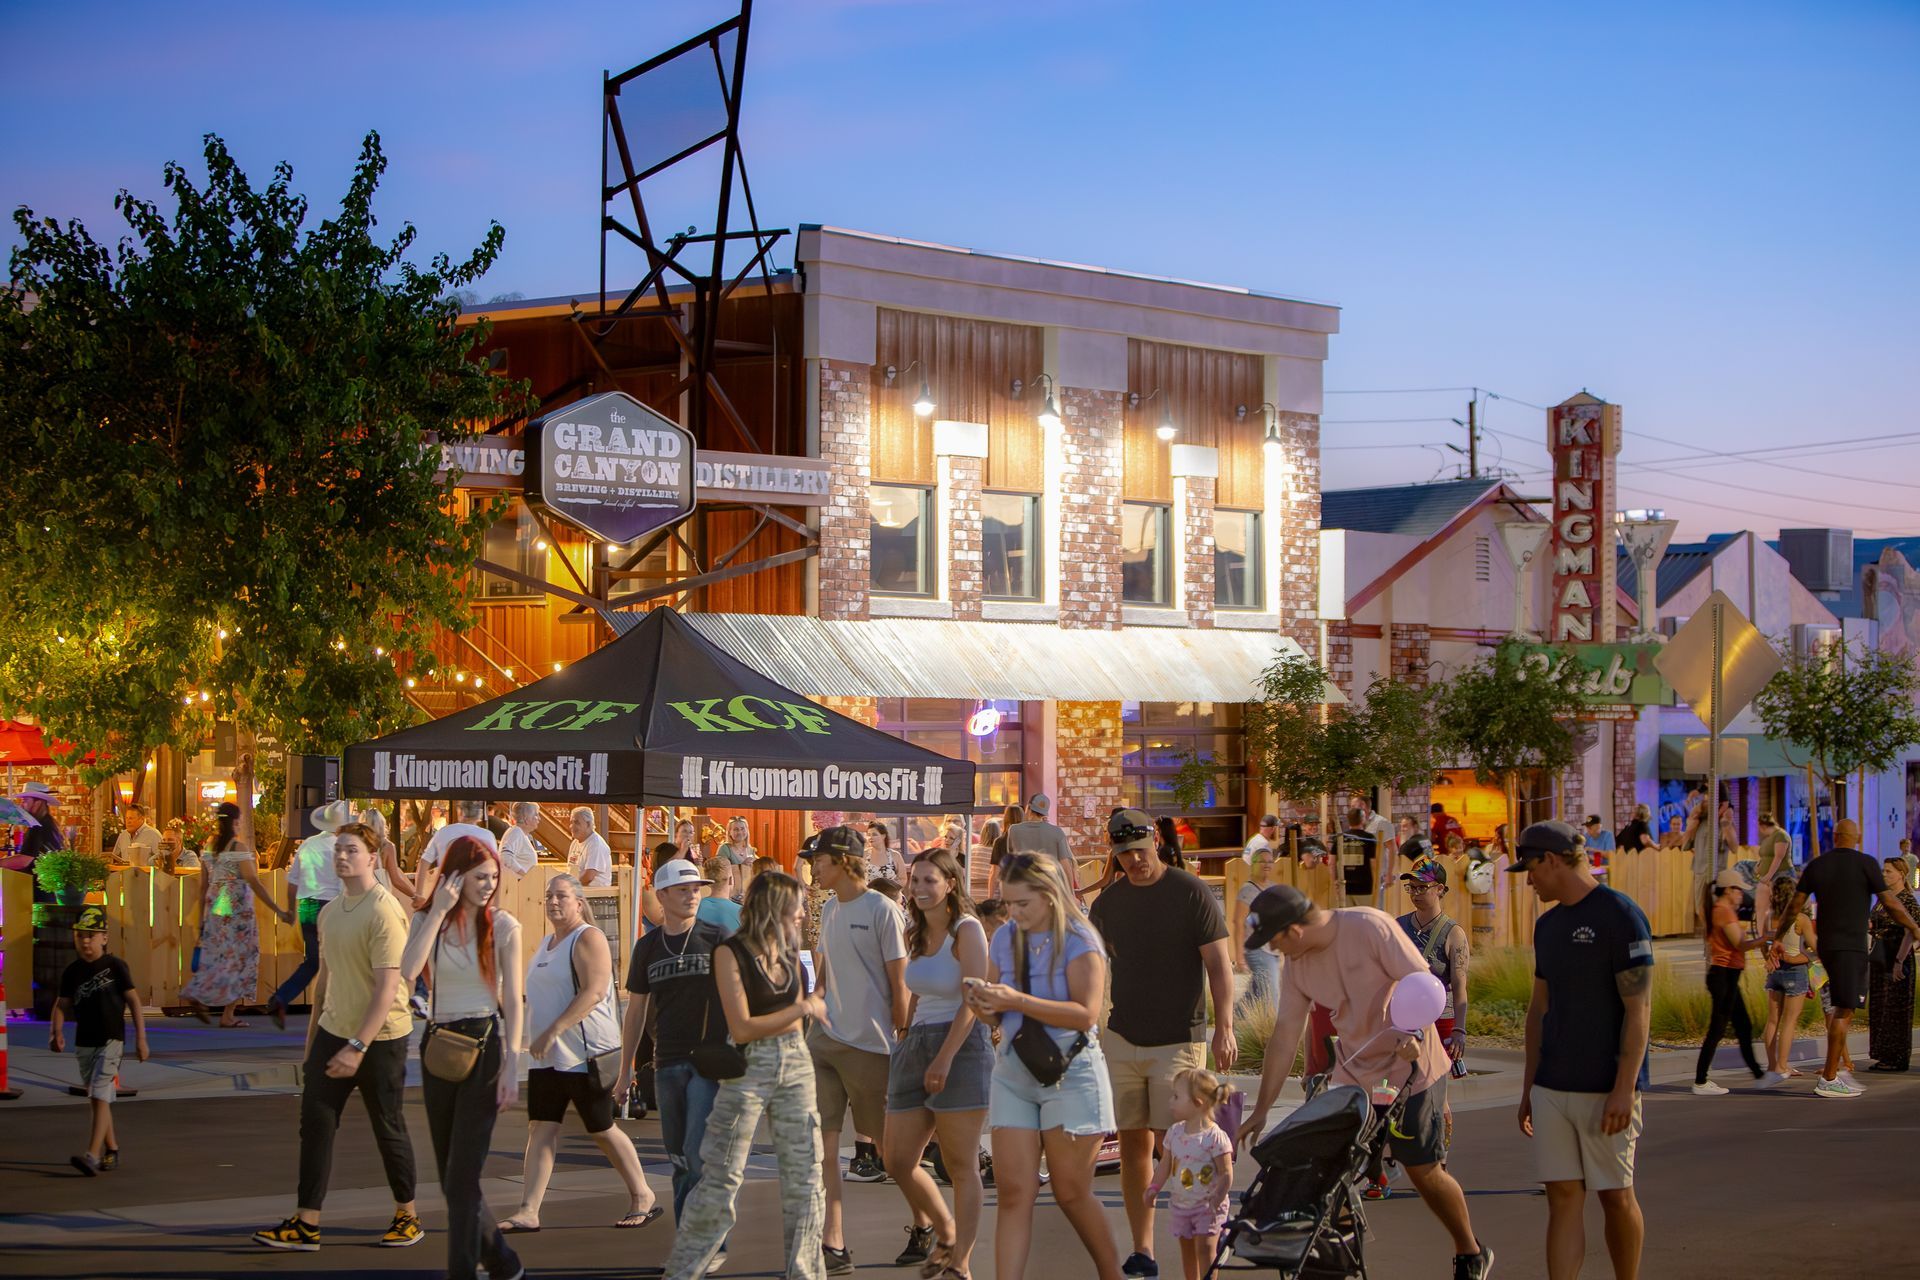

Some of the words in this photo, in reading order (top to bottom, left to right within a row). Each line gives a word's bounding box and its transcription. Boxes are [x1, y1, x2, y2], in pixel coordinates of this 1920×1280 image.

[610, 406, 626, 424] the
[554, 422, 681, 458] GRAND
[400, 441, 525, 475] EWING
[554, 453, 681, 486] CANYON
[555, 482, 608, 495] BREWING
[617, 487, 680, 500] DISTILLERY
[696, 461, 832, 496] DISTILLERY
[1560, 418, 1595, 641] KINGMAN
[464, 700, 639, 732] KCF
[667, 694, 832, 735] KCF
[395, 754, 489, 792] Kingman
[493, 754, 584, 791] CrossFit
[708, 760, 818, 801] Kingman
[823, 764, 918, 801] CrossFit
